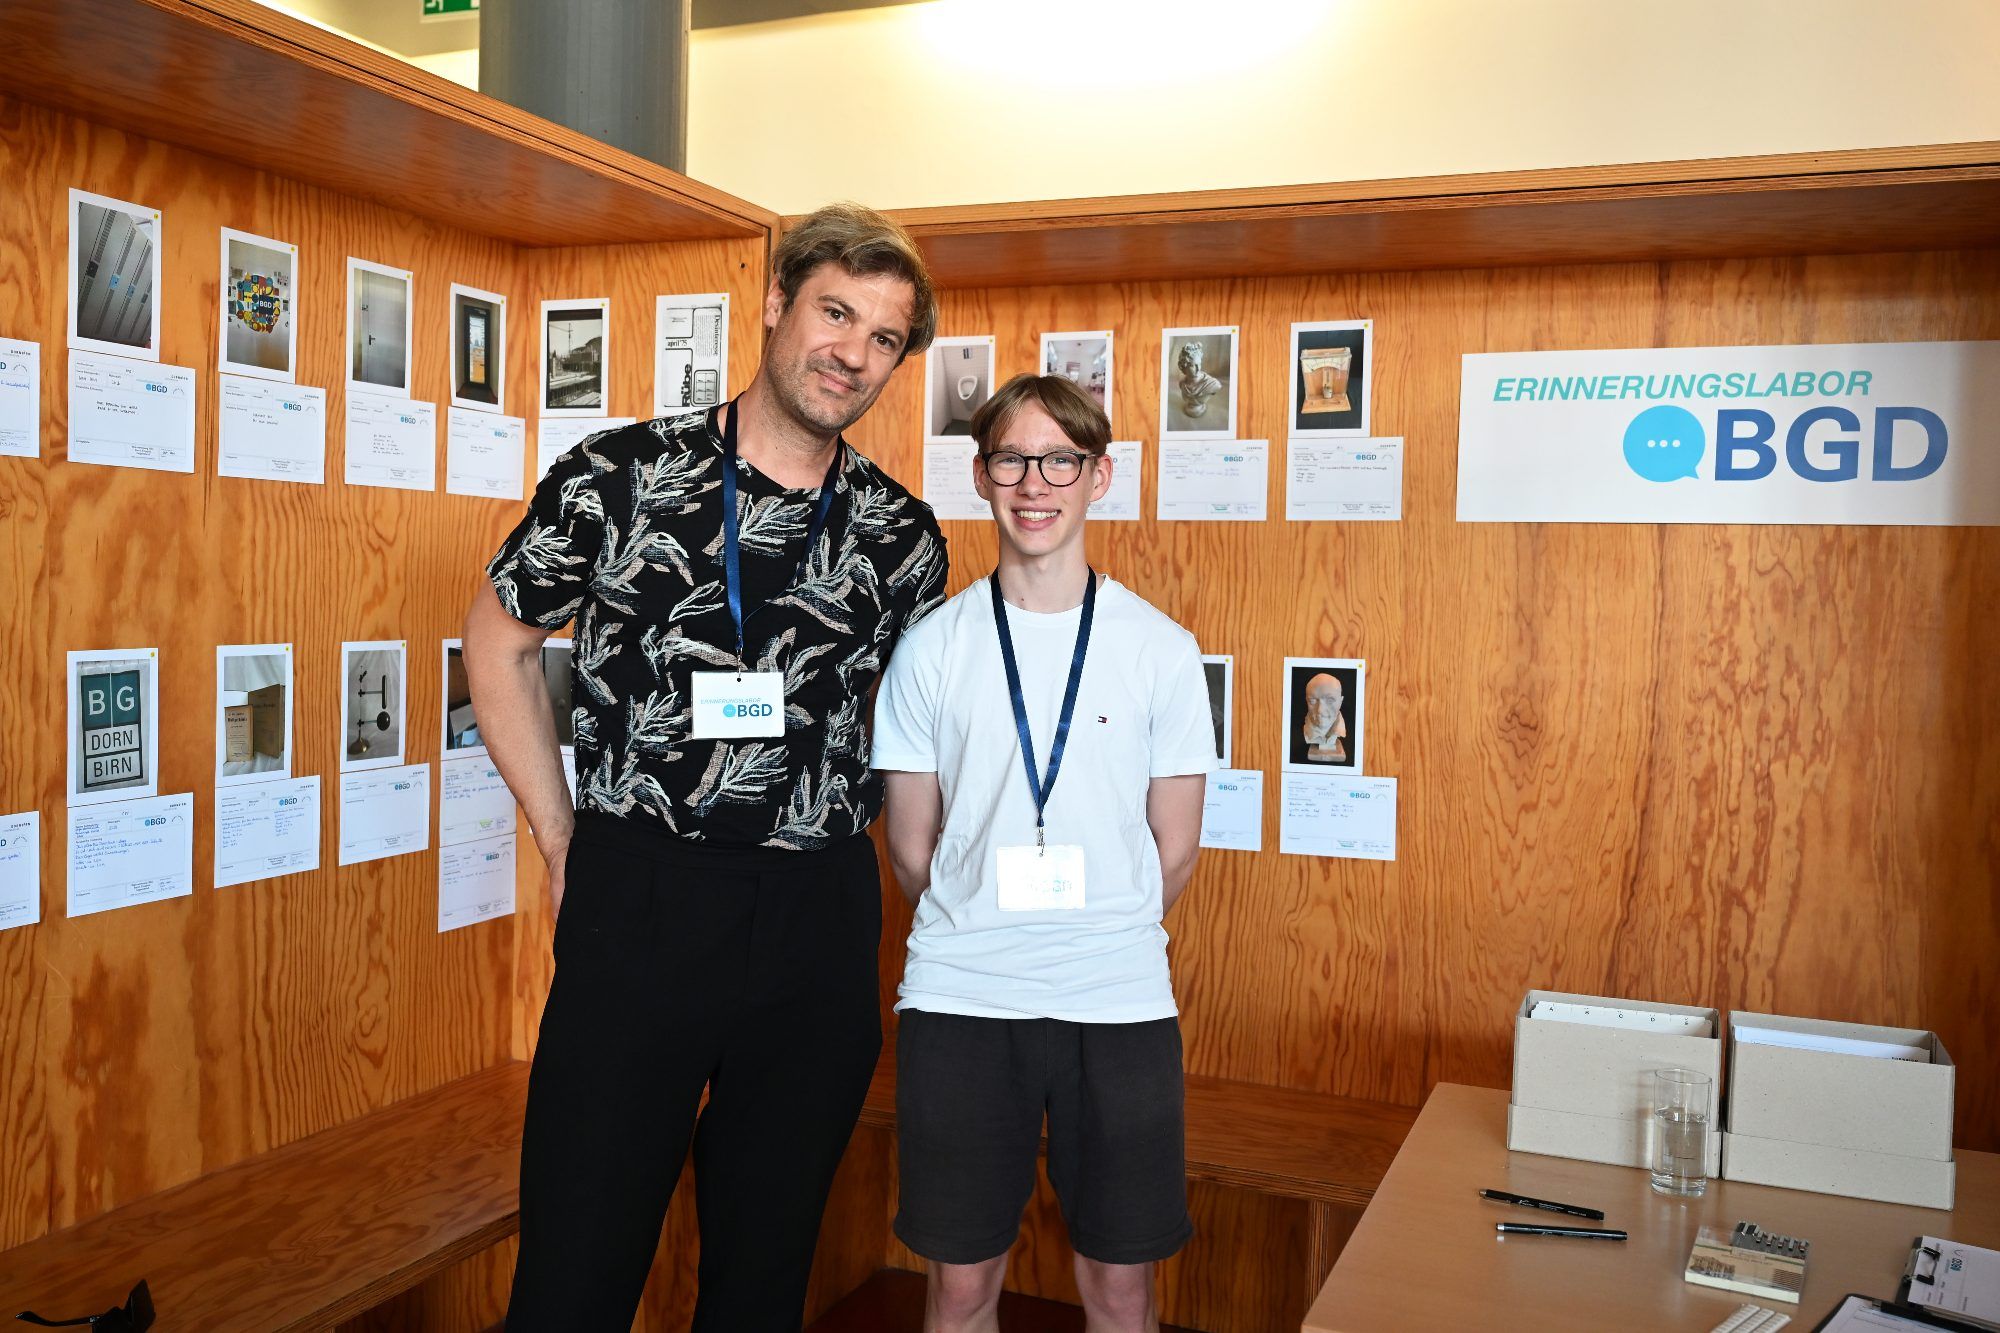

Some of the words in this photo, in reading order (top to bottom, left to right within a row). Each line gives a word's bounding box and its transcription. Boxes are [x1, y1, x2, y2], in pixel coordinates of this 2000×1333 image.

[152, 384, 167, 393] BGD
[681, 364, 692, 407] Rübe
[1493, 370, 1872, 402] ERINNERUNGSLABOR
[289, 403, 302, 411] BGD
[1714, 406, 1948, 483] BGD
[738, 704, 772, 717] BGD
[92, 730, 133, 750] DORN
[94, 756, 132, 778] BIRN
[151, 818, 166, 826] BGD
